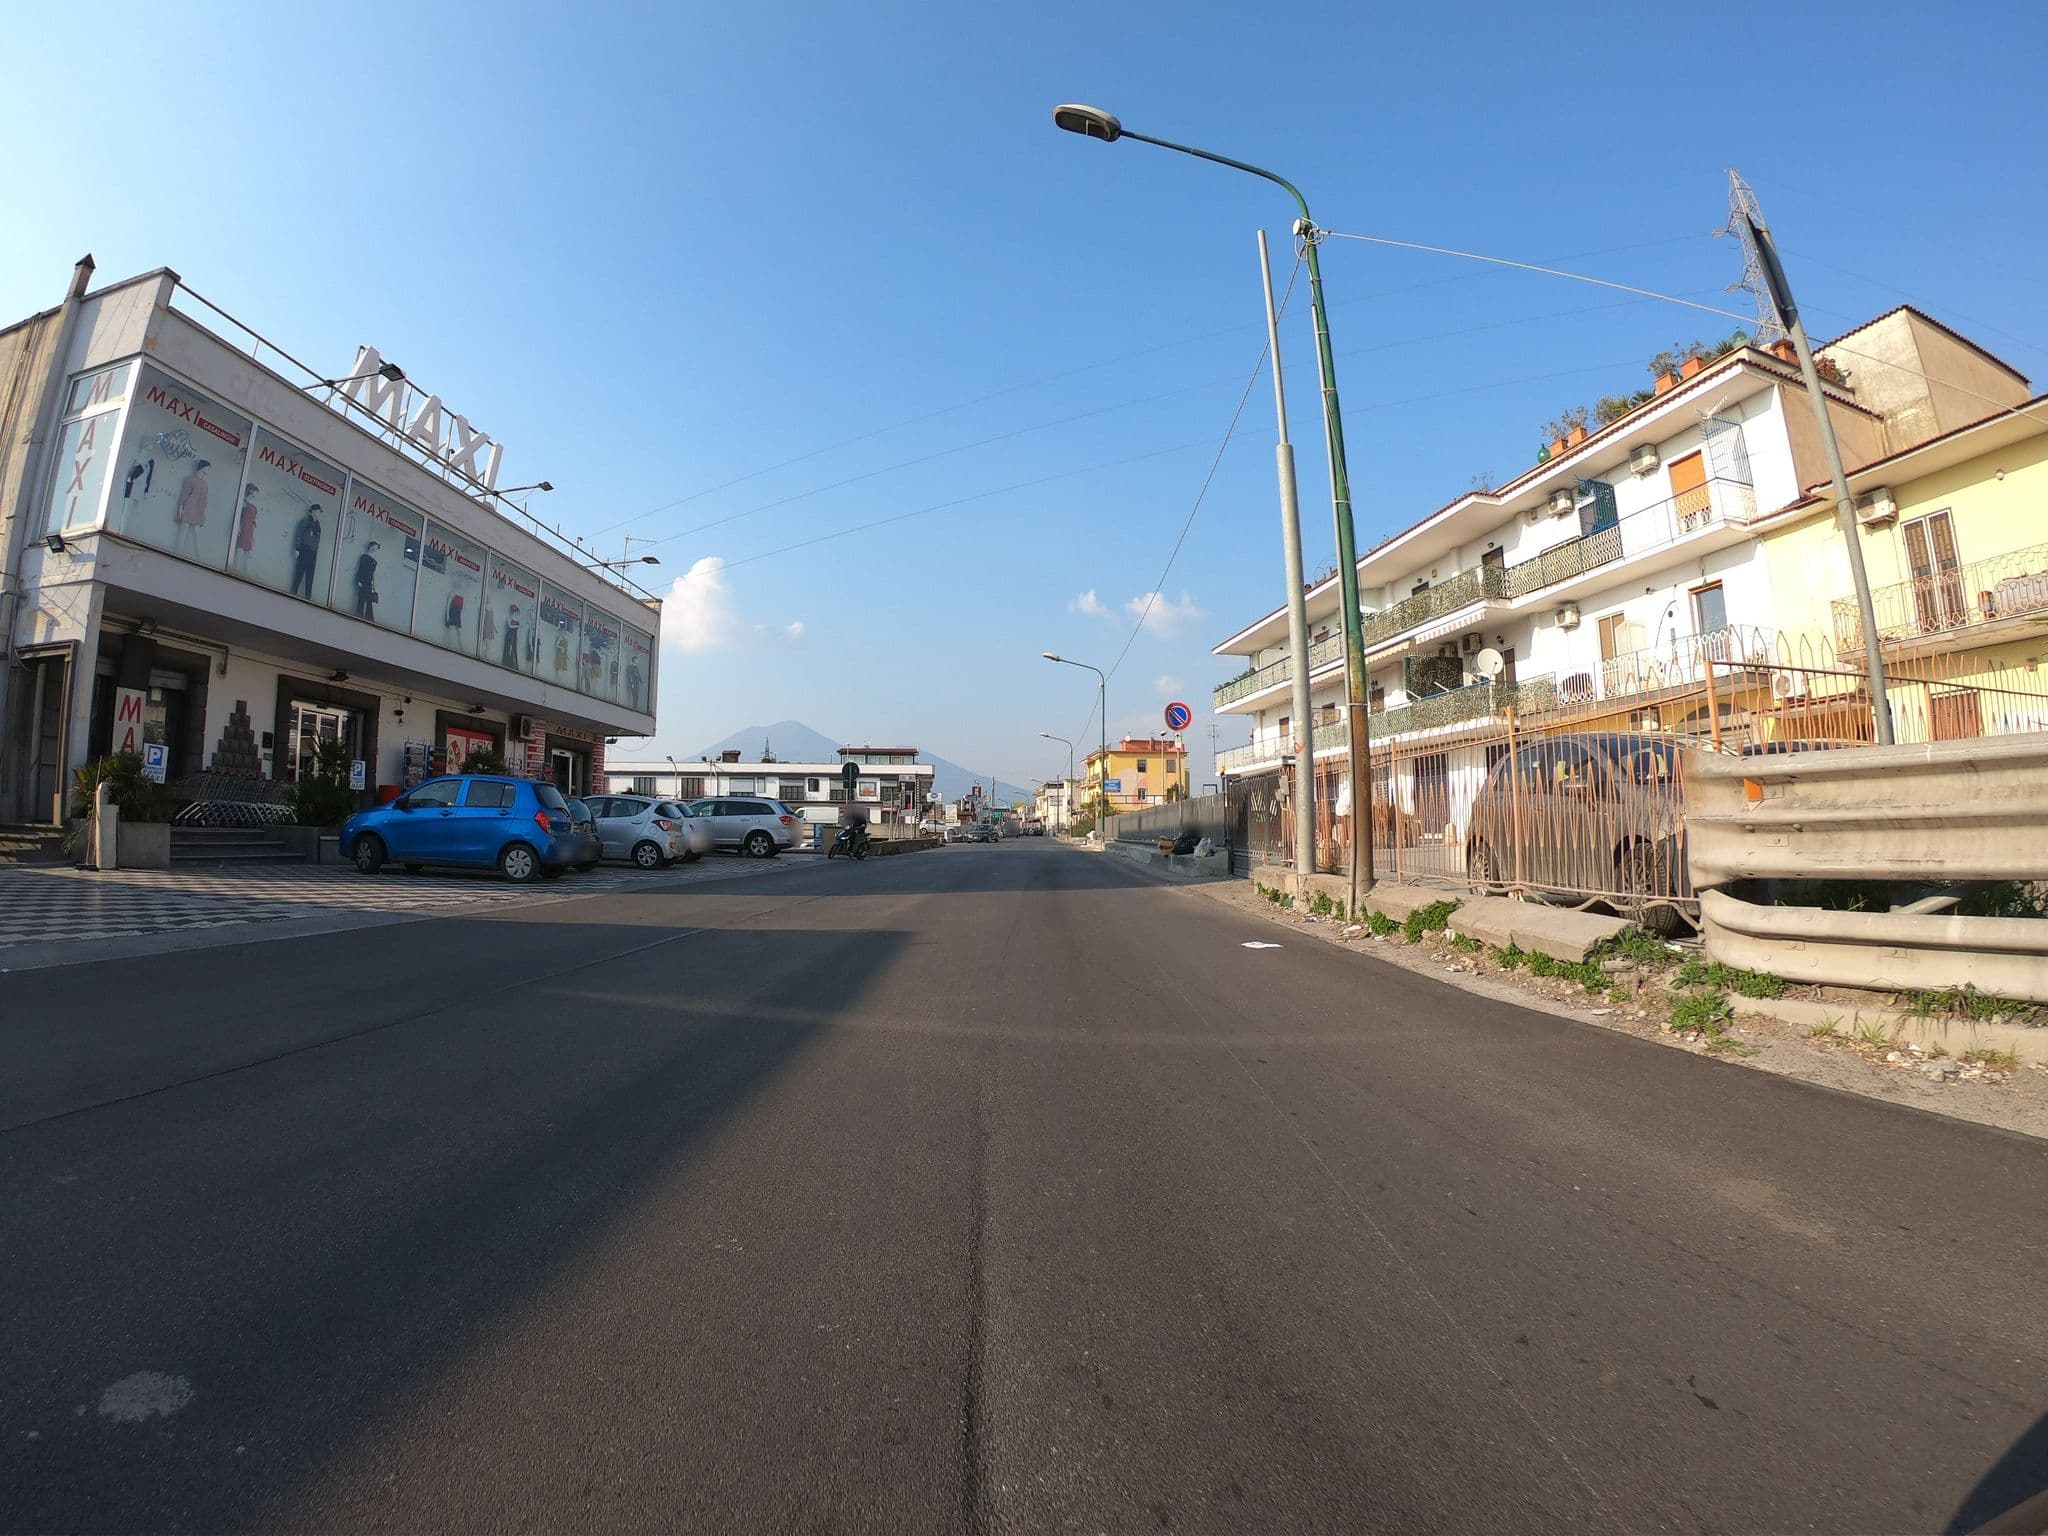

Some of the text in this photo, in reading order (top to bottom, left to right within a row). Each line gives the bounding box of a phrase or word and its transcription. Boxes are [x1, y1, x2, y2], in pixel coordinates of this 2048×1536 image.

[147, 386, 200, 424] MAXI
[341, 346, 503, 495] MAXI
[66, 372, 113, 528] MAXI
[259, 446, 303, 478] MAXI
[354, 496, 390, 524] MAXI
[430, 537, 458, 560] MAXI
[492, 569, 517, 589] MAXI
[544, 595, 564, 612] MAXI
[556, 726, 587, 739] MAXI
[149, 747, 161, 763] P
